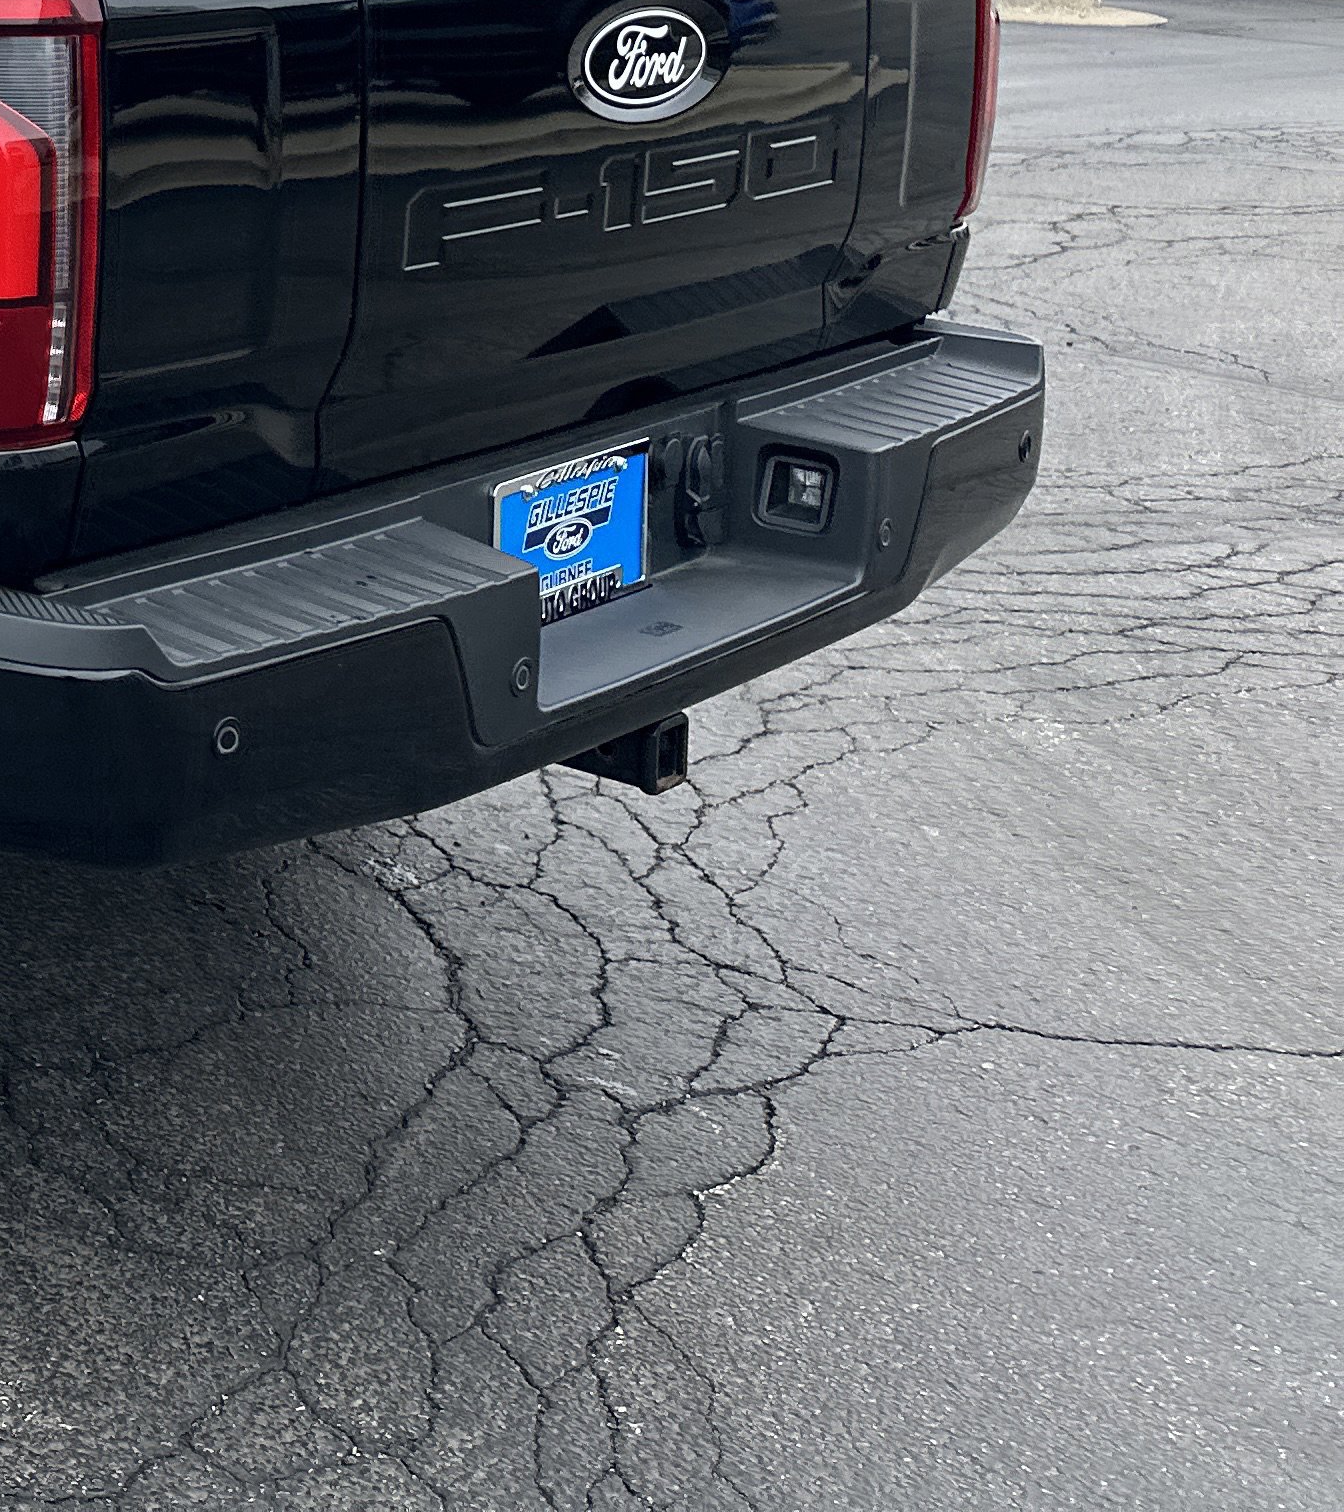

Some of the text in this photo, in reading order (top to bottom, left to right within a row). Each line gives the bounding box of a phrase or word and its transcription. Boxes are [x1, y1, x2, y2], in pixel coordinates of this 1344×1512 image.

[608, 24, 688, 91] Ford
[402, 118, 840, 272] F-150
[527, 476, 619, 530] GILLESPIE
[552, 525, 584, 554] Ford
[540, 558, 593, 592] GURNEE
[541, 570, 619, 624] UTO GROUP
